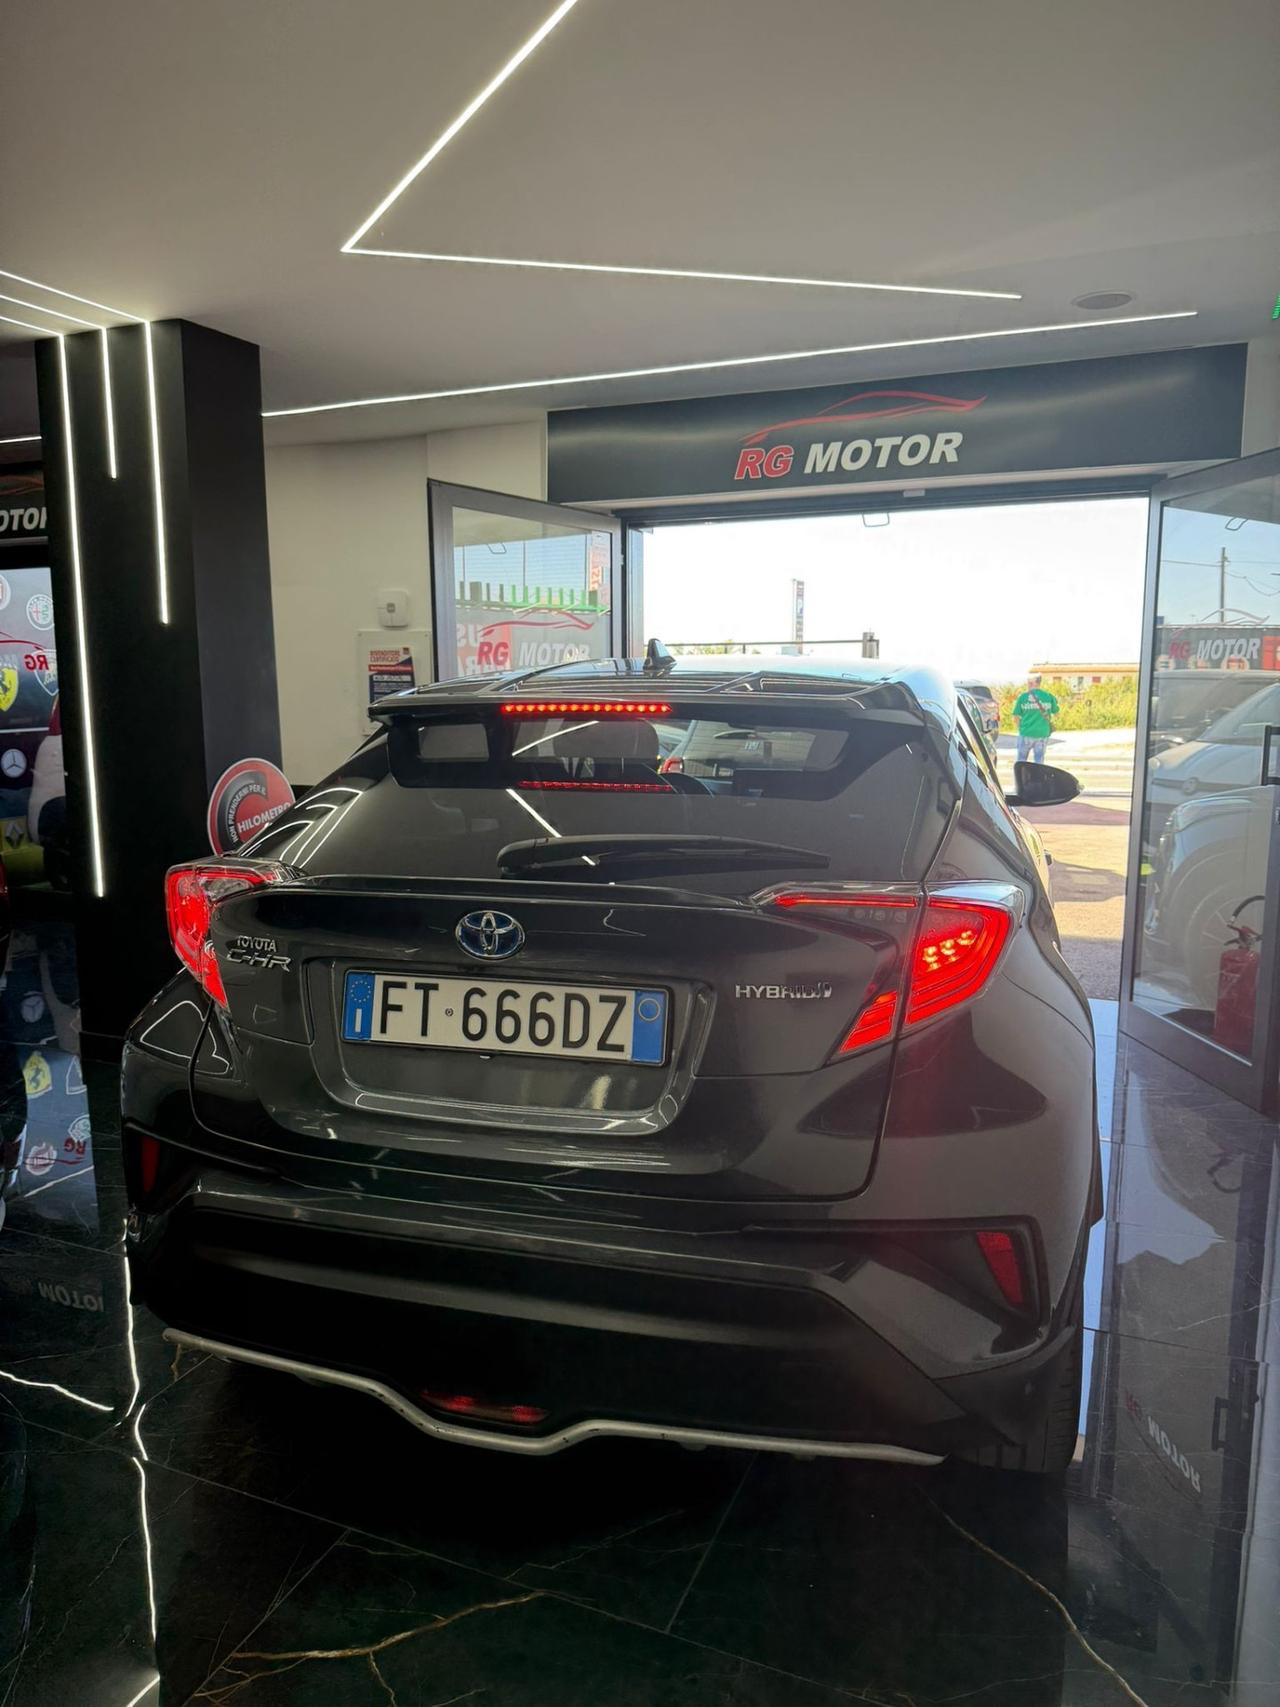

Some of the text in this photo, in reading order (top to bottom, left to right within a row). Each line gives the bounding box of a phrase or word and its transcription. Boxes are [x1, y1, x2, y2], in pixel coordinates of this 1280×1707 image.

[734, 432, 963, 480] RG MOTOR
[477, 642, 509, 666] RG
[518, 642, 591, 666] MOTOR
[1197, 638, 1261, 660] MOTOR
[229, 827, 239, 843] NON
[237, 935, 276, 952] TOYOTA
[226, 948, 291, 972] C-HR
[380, 981, 439, 1037] FT
[461, 987, 627, 1052] 666DZ
